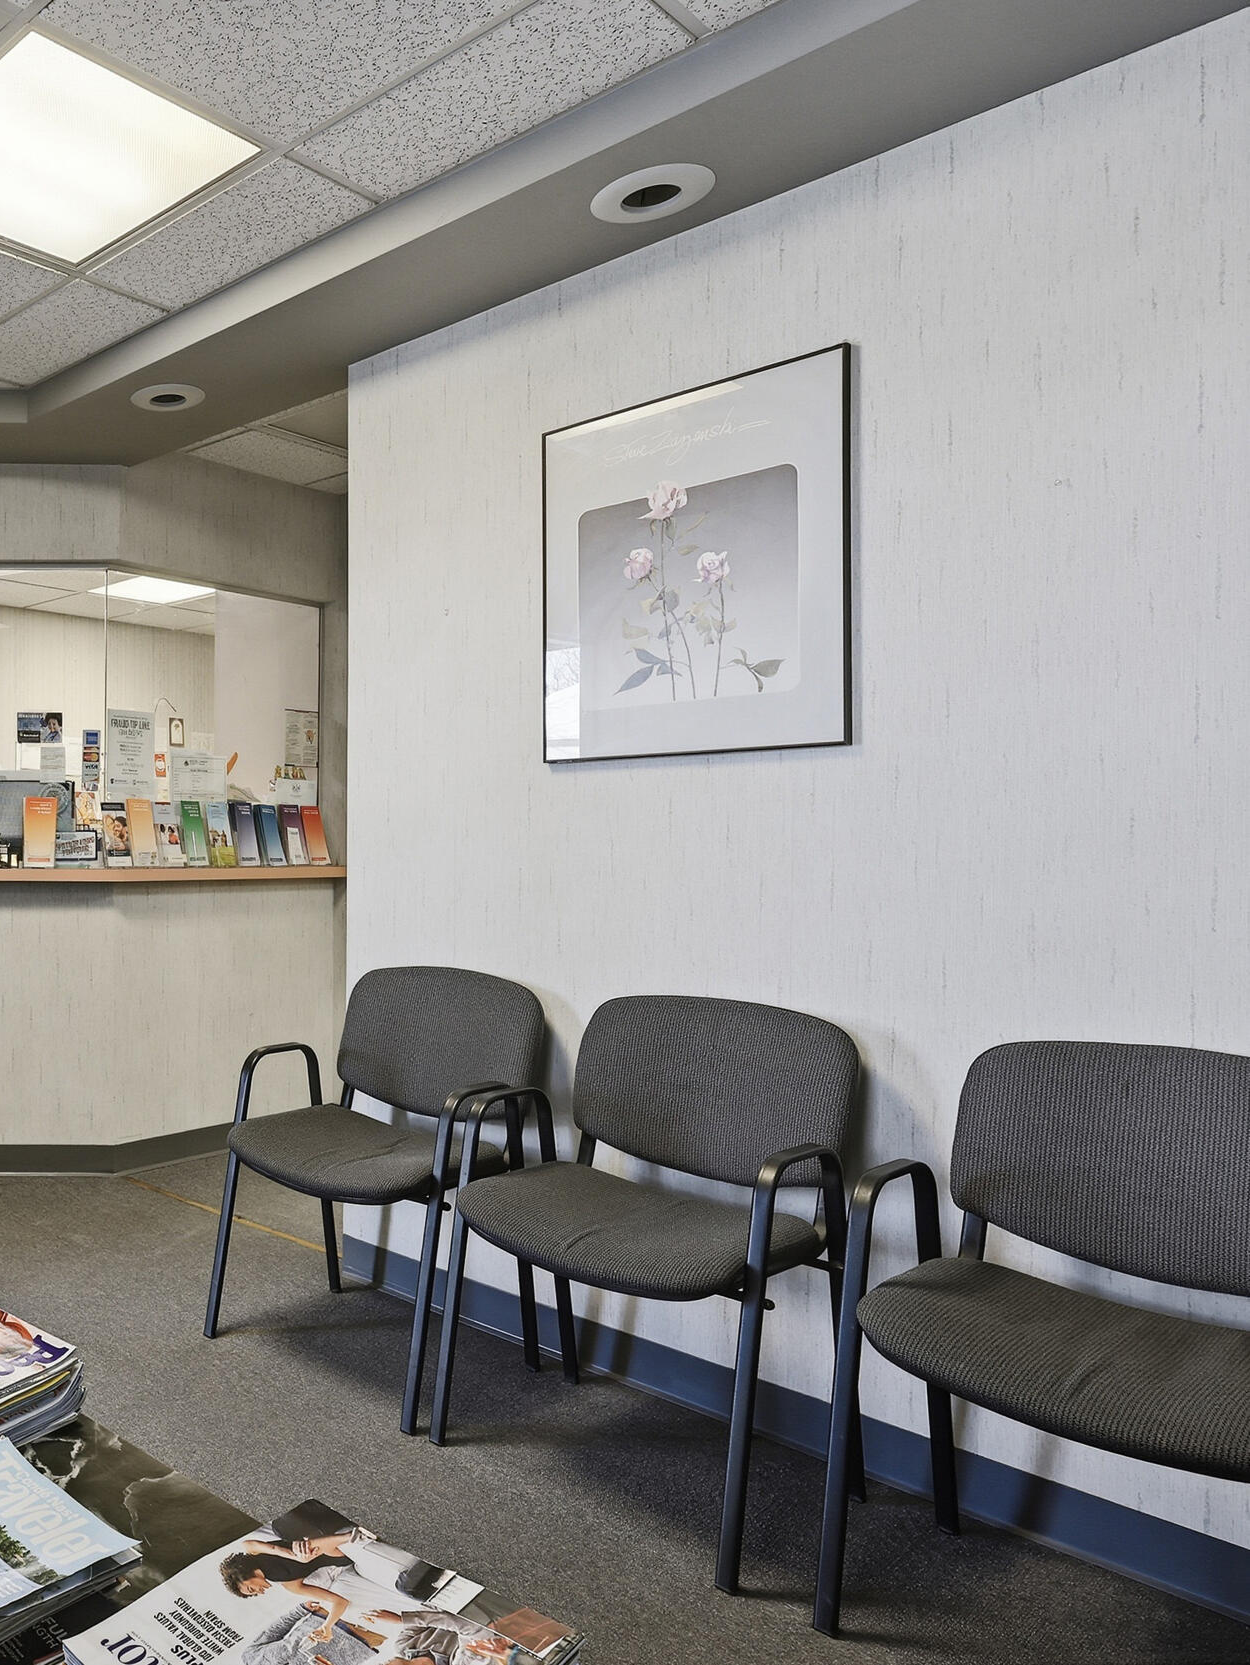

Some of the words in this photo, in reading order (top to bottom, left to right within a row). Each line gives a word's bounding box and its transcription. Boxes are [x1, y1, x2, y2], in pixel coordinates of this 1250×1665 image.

[154, 1611, 178, 1634] VALUES
[174, 1597, 214, 1631] DISCOVERIES
[205, 1610, 226, 1628] SPAIN
[169, 1610, 206, 1640] BURGUNDY
[223, 1626, 244, 1642] FROM
[176, 1631, 202, 1653] GLOBAL
[200, 1636, 225, 1656] WHITE
[211, 1629, 236, 1648] FRESH
